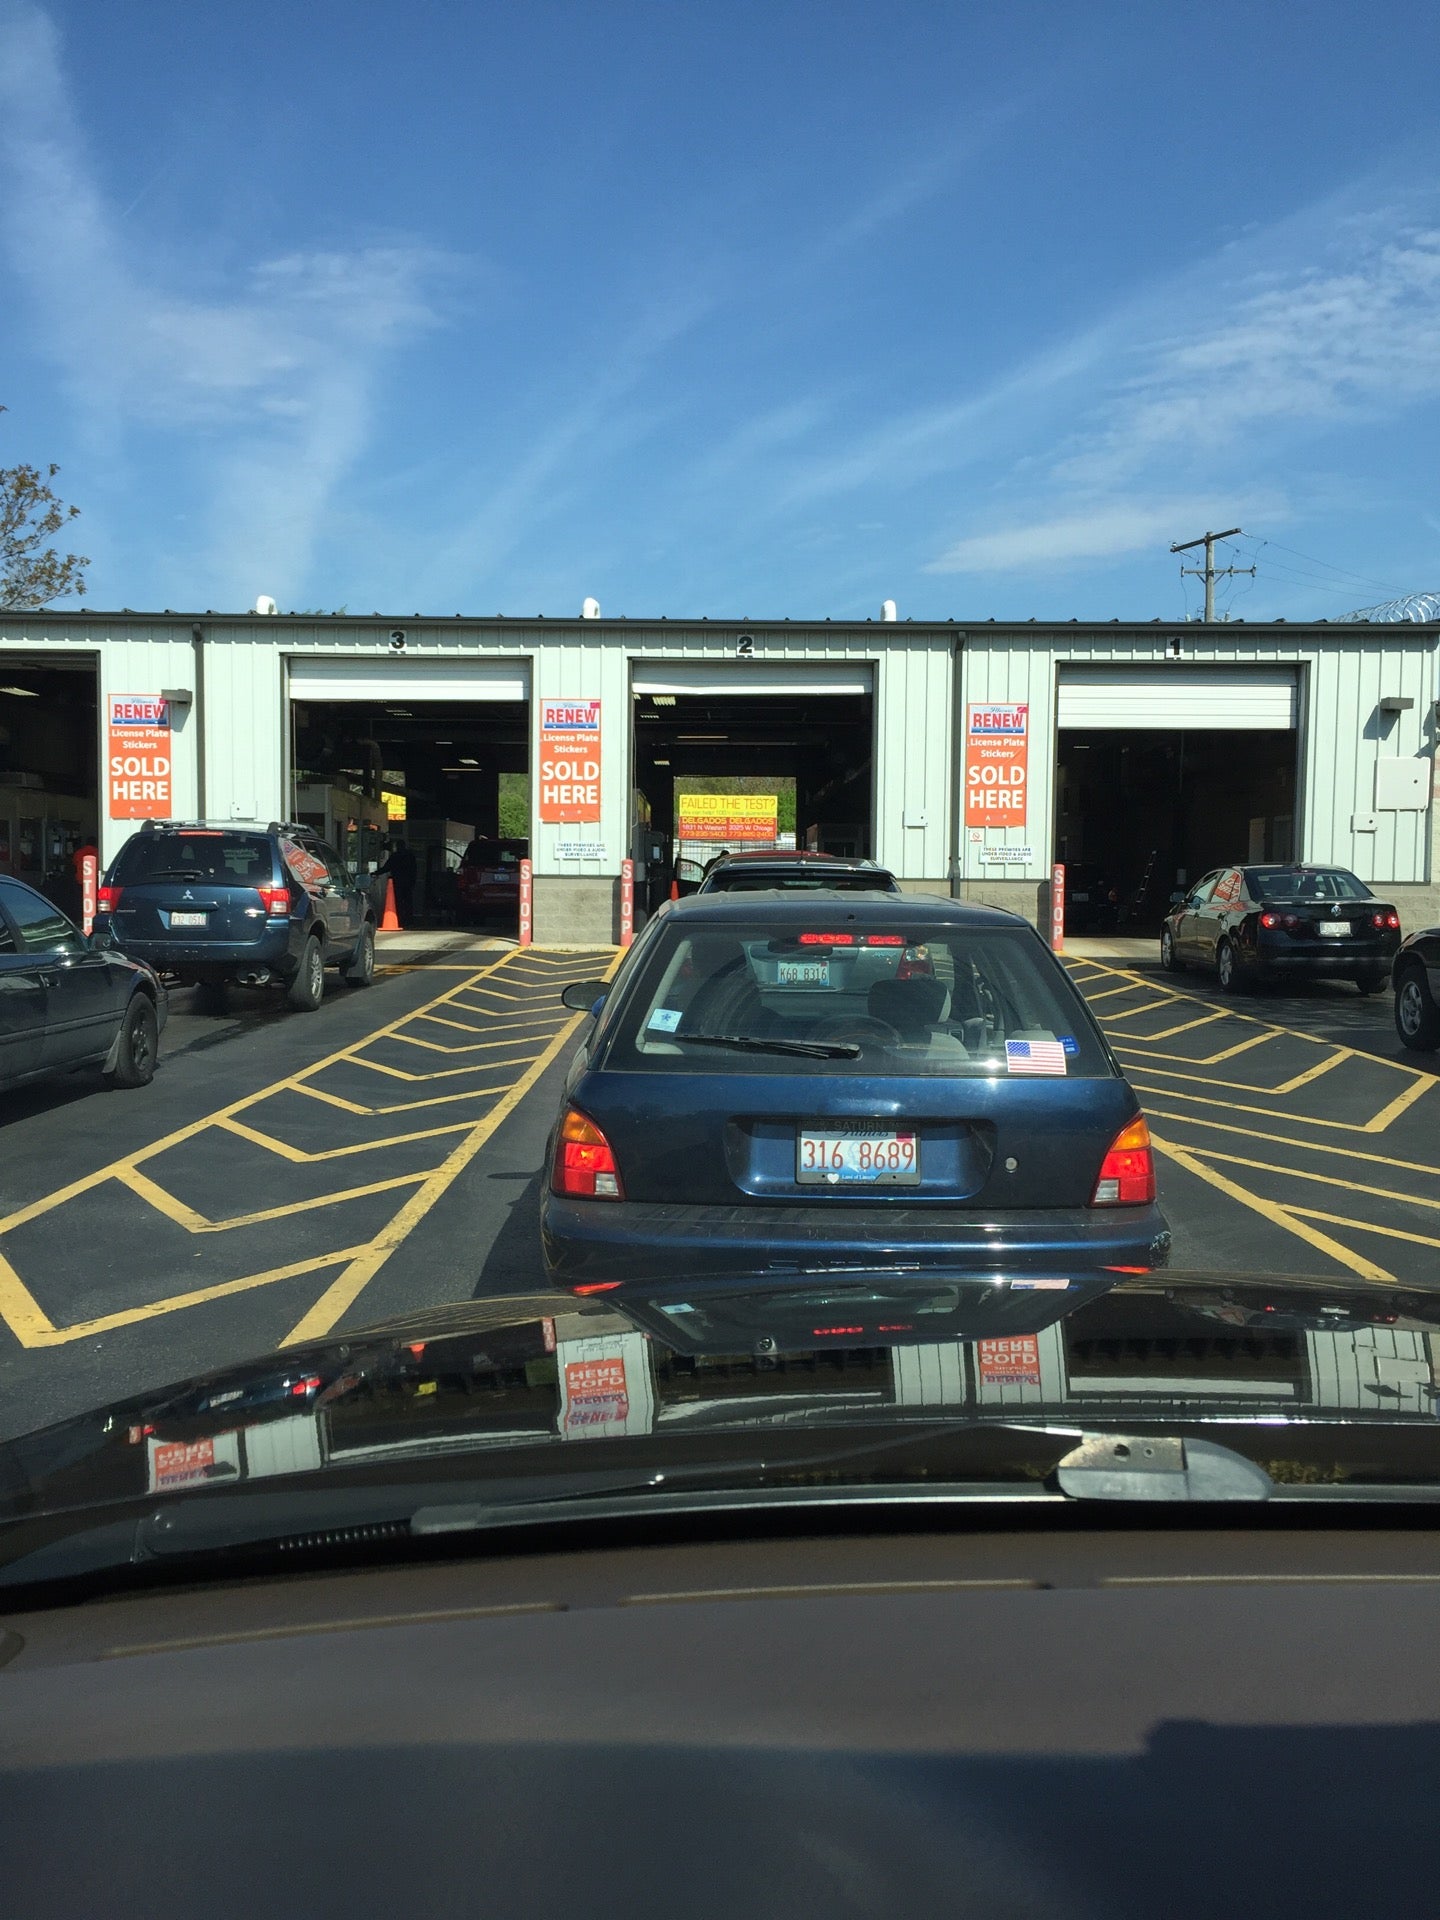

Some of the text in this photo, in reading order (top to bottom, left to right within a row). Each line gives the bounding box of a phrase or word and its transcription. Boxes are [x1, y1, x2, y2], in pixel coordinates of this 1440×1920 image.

[391, 631, 405, 649] 3
[739, 636, 753, 653] 2
[1170, 638, 1180, 655] 1
[114, 704, 166, 719] RENEW
[546, 709, 596, 723] RENEW
[973, 713, 1023, 728] RENEW
[112, 729, 169, 738] License Plate
[543, 733, 599, 742] License Plate
[970, 738, 1025, 746] License Plate
[122, 741, 157, 749] Stickers
[554, 745, 588, 753] Stickers
[981, 749, 1014, 758] Stickers
[111, 757, 170, 777] SOLD
[542, 761, 600, 781] SOLD
[968, 765, 1025, 785] SOLD
[113, 781, 169, 800] HERE
[543, 785, 598, 804] HERE
[969, 789, 1023, 809] HERE
[681, 797, 776, 810] FAILED THE TEST?
[682, 817, 727, 825] DELGADOS
[83, 860, 93, 932] STOP
[520, 865, 530, 935] STOP
[621, 865, 631, 935] STOP
[1053, 869, 1064, 940] STOP
[803, 968, 827, 980] 8316
[834, 1121, 884, 1131] SATURN
[803, 1140, 914, 1170] 316 8689
